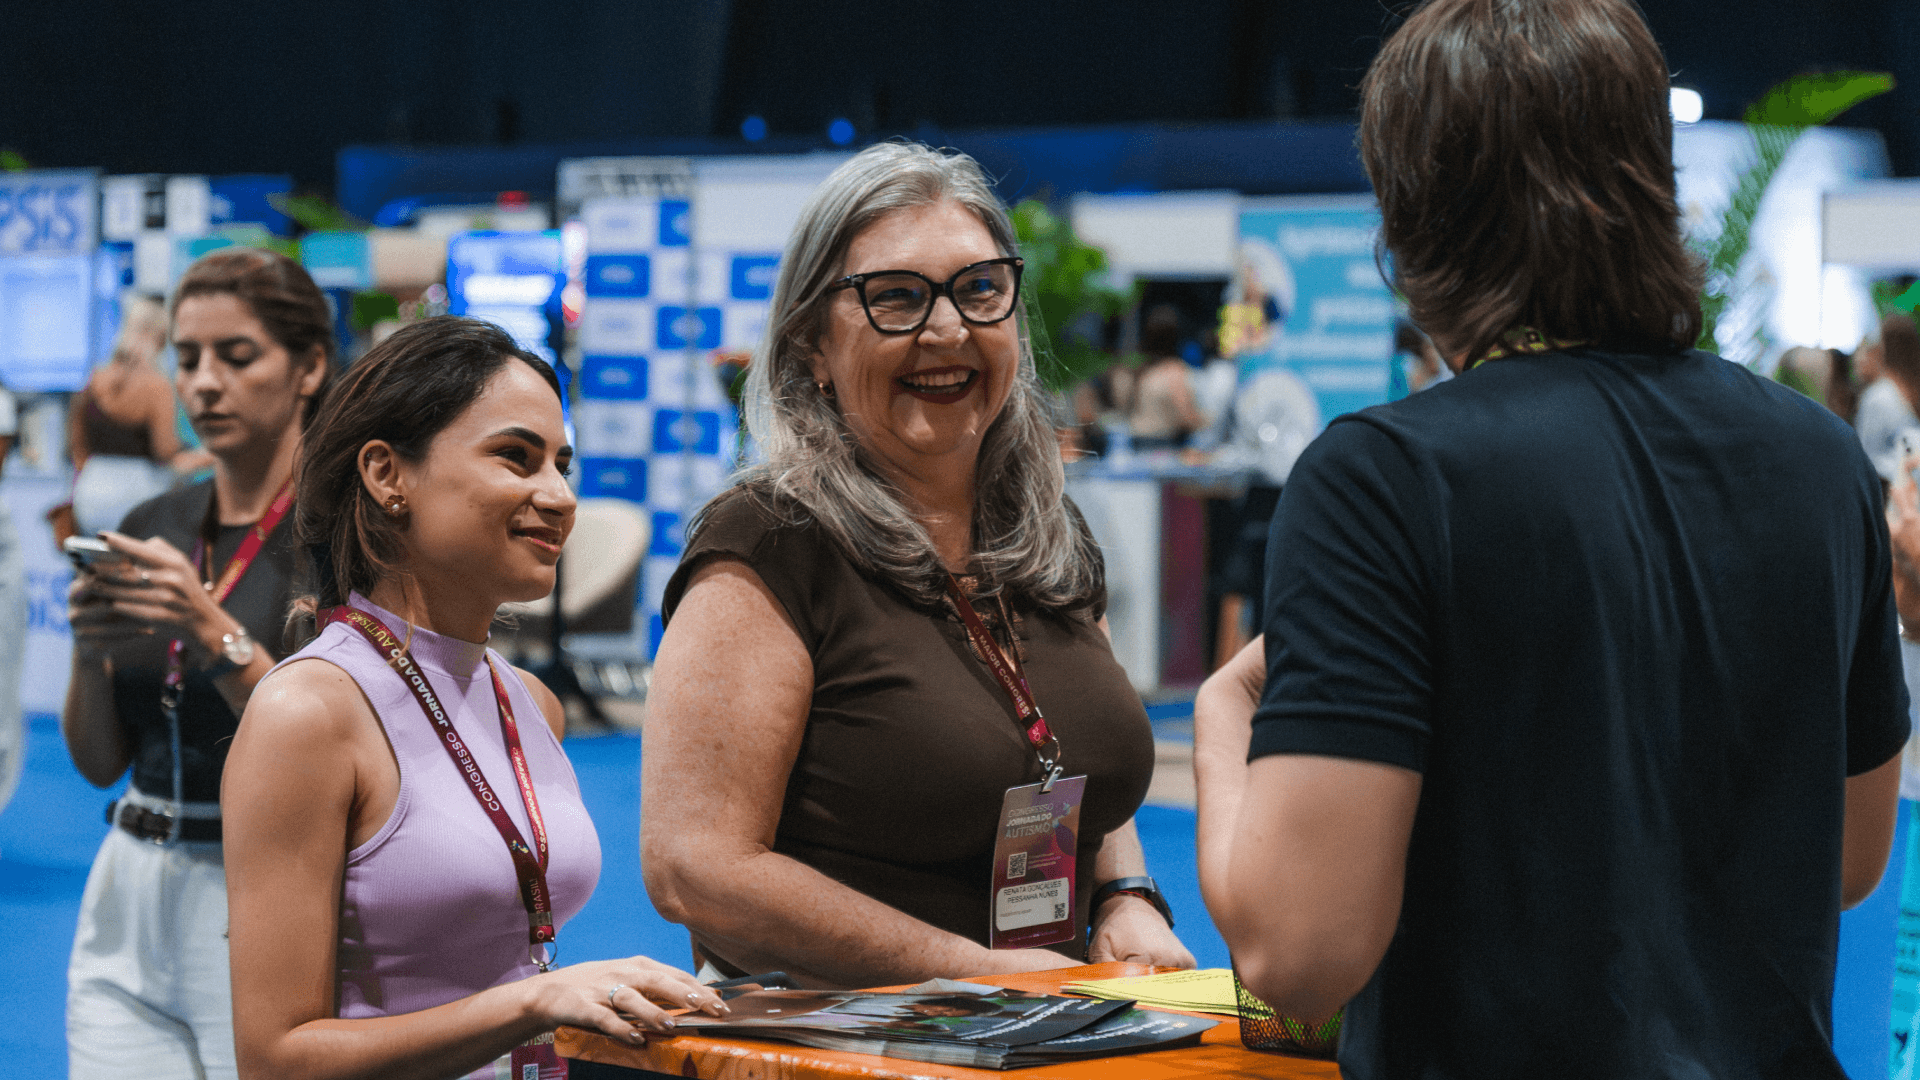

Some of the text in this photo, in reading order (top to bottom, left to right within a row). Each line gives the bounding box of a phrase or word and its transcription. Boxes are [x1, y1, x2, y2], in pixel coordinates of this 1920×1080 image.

[346, 611, 396, 651] AUTISMO
[979, 634, 1002, 668] MAIOR
[404, 664, 449, 728] JORNADA
[445, 731, 499, 812] CONGRESSO
[1008, 803, 1054, 817] CONGRESSO
[1005, 814, 1041, 827] JORNADA
[1005, 822, 1051, 839] AUTISMO
[1003, 886, 1026, 896] RENATA
[1007, 889, 1059, 904] PESSANHA NUNES
[521, 1032, 555, 1047] UTISMO
